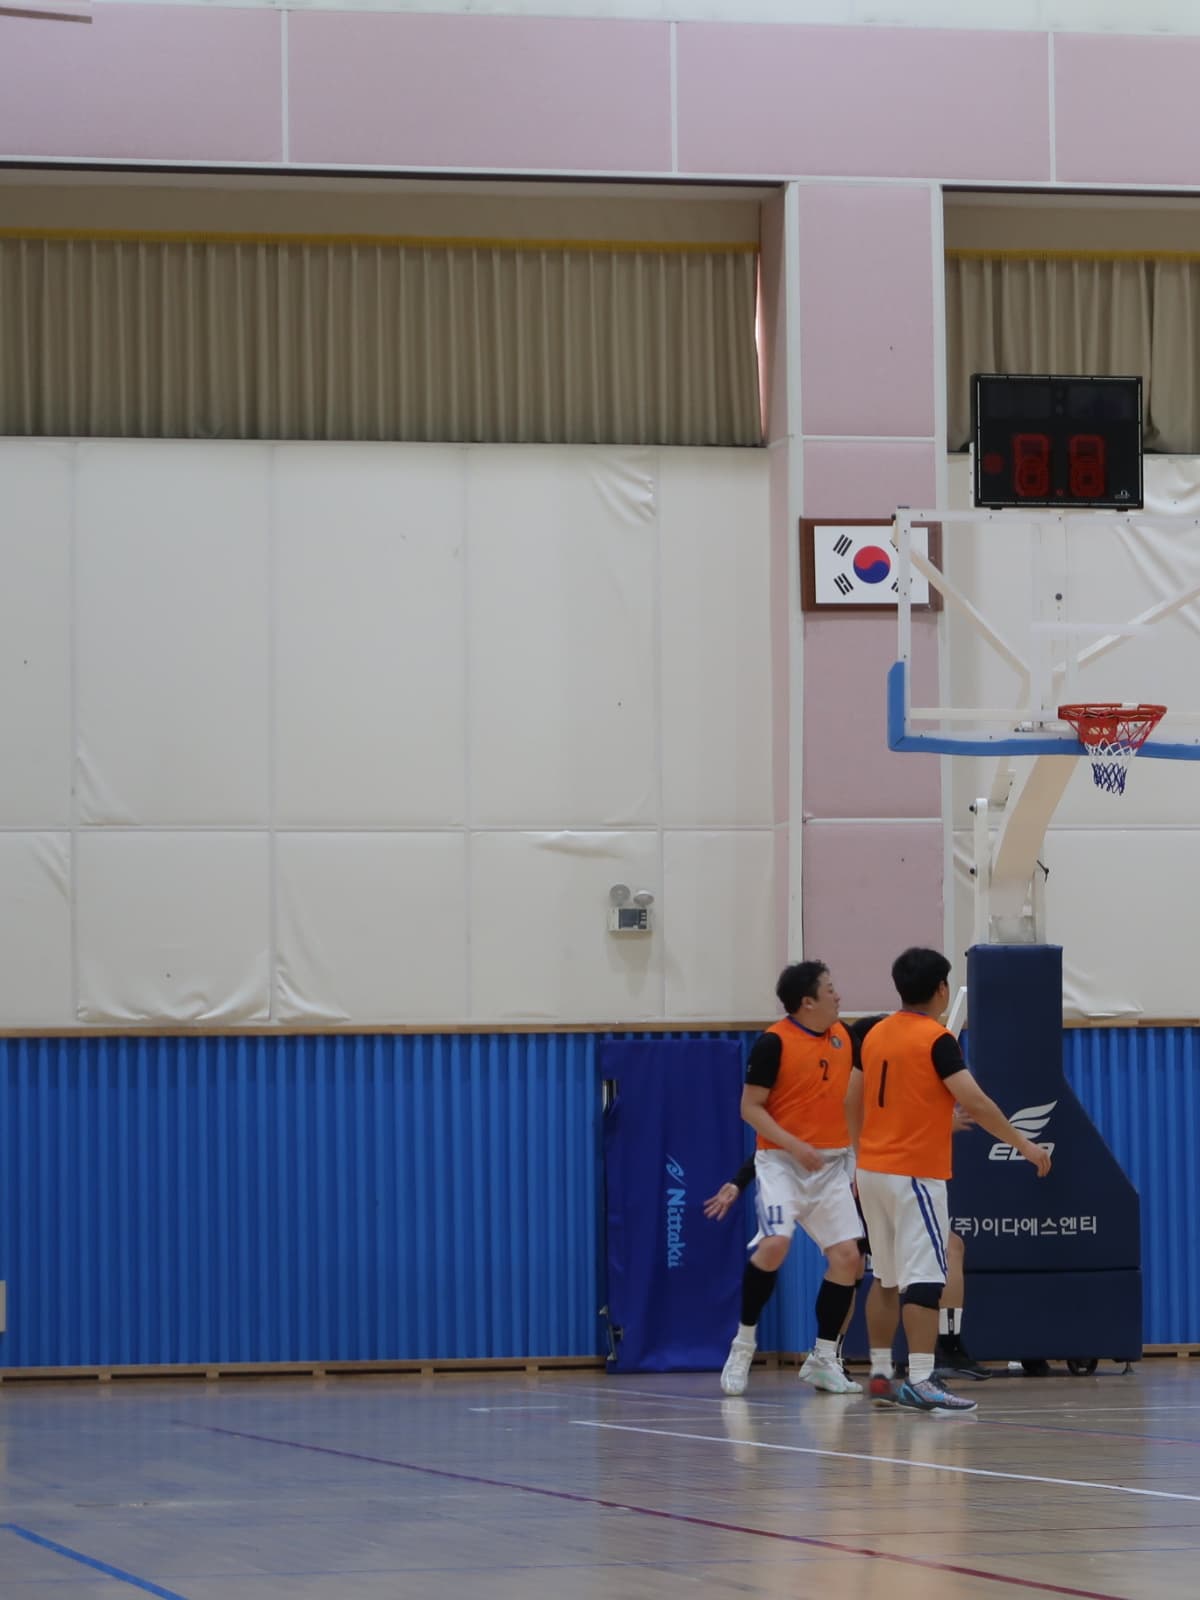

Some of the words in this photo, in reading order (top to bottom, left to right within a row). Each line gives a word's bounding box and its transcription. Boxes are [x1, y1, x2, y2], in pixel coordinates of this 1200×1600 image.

[819, 1059, 829, 1081] 2
[878, 1060, 888, 1108] 1
[766, 1205, 783, 1226] 11
[949, 1215, 1097, 1237] (주)이다에스엔티
[667, 1188, 686, 1269] Nittaku
